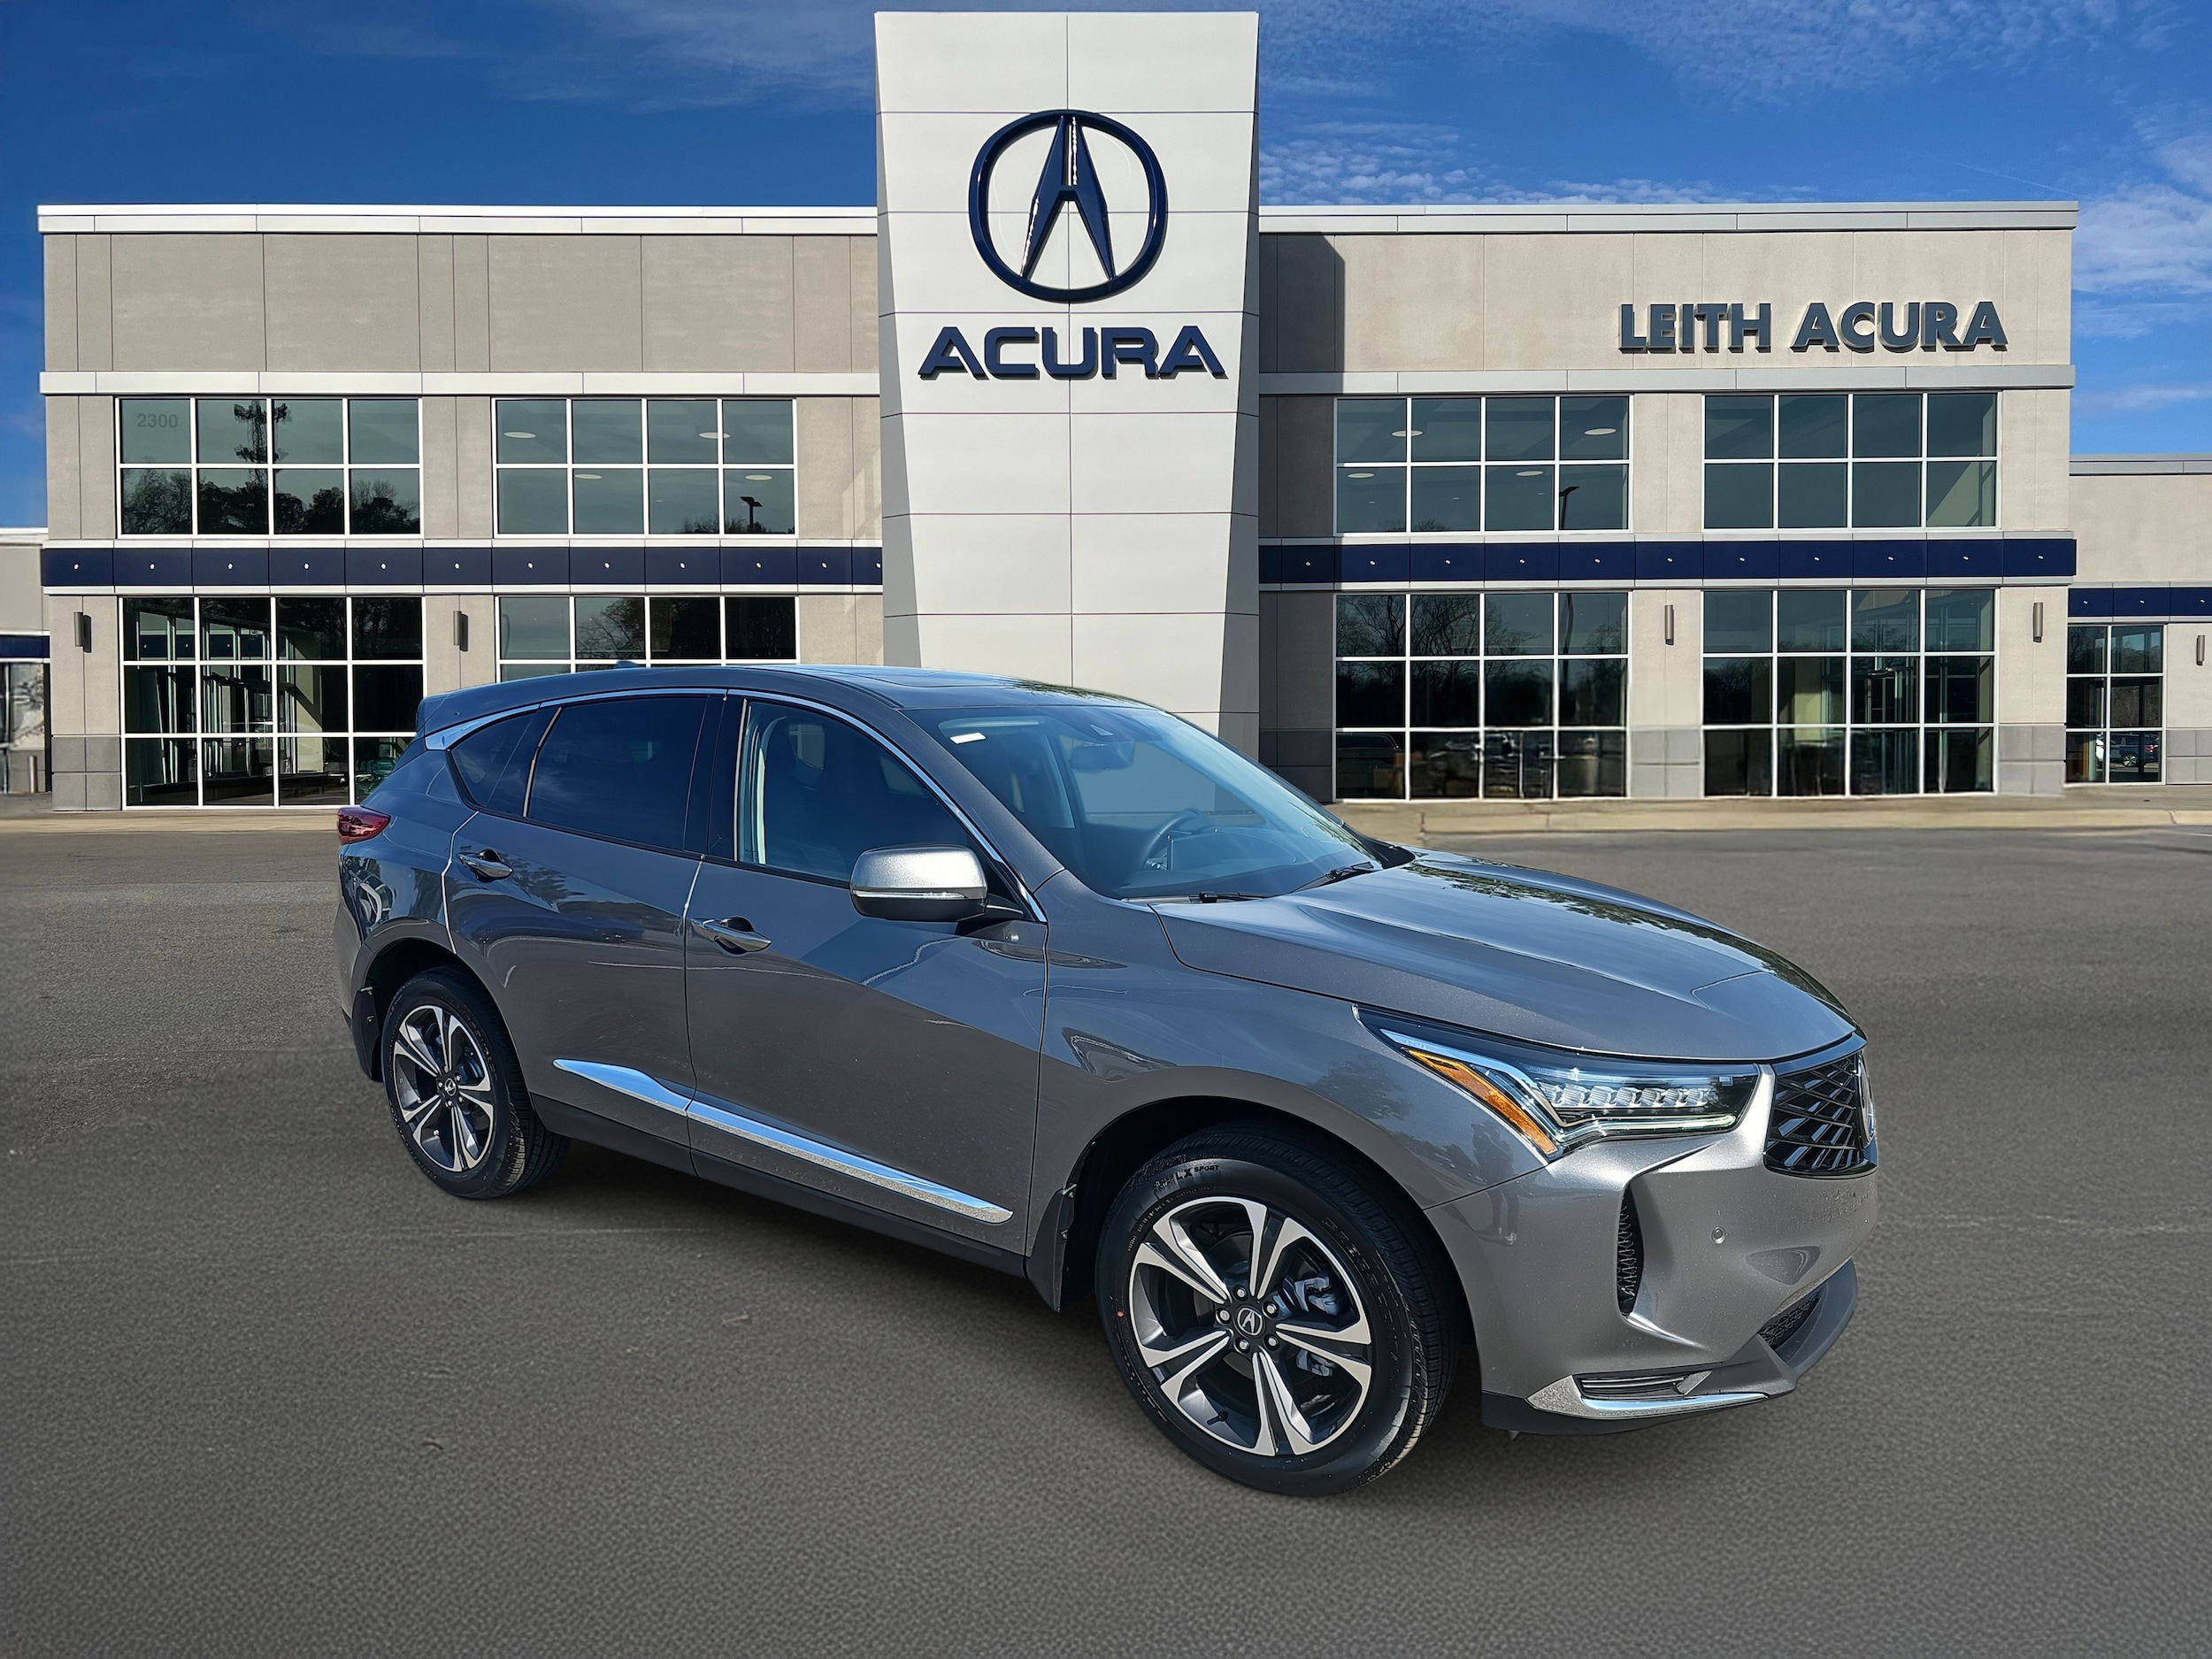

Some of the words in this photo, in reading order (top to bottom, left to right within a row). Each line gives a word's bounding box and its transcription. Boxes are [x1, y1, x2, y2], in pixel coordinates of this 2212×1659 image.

[1618, 303, 1771, 353] LEITH
[1790, 300, 2008, 353] ACURA
[918, 326, 1228, 380] ACURA
[137, 413, 178, 428] 2300
[1175, 1168, 1193, 1179] LX
